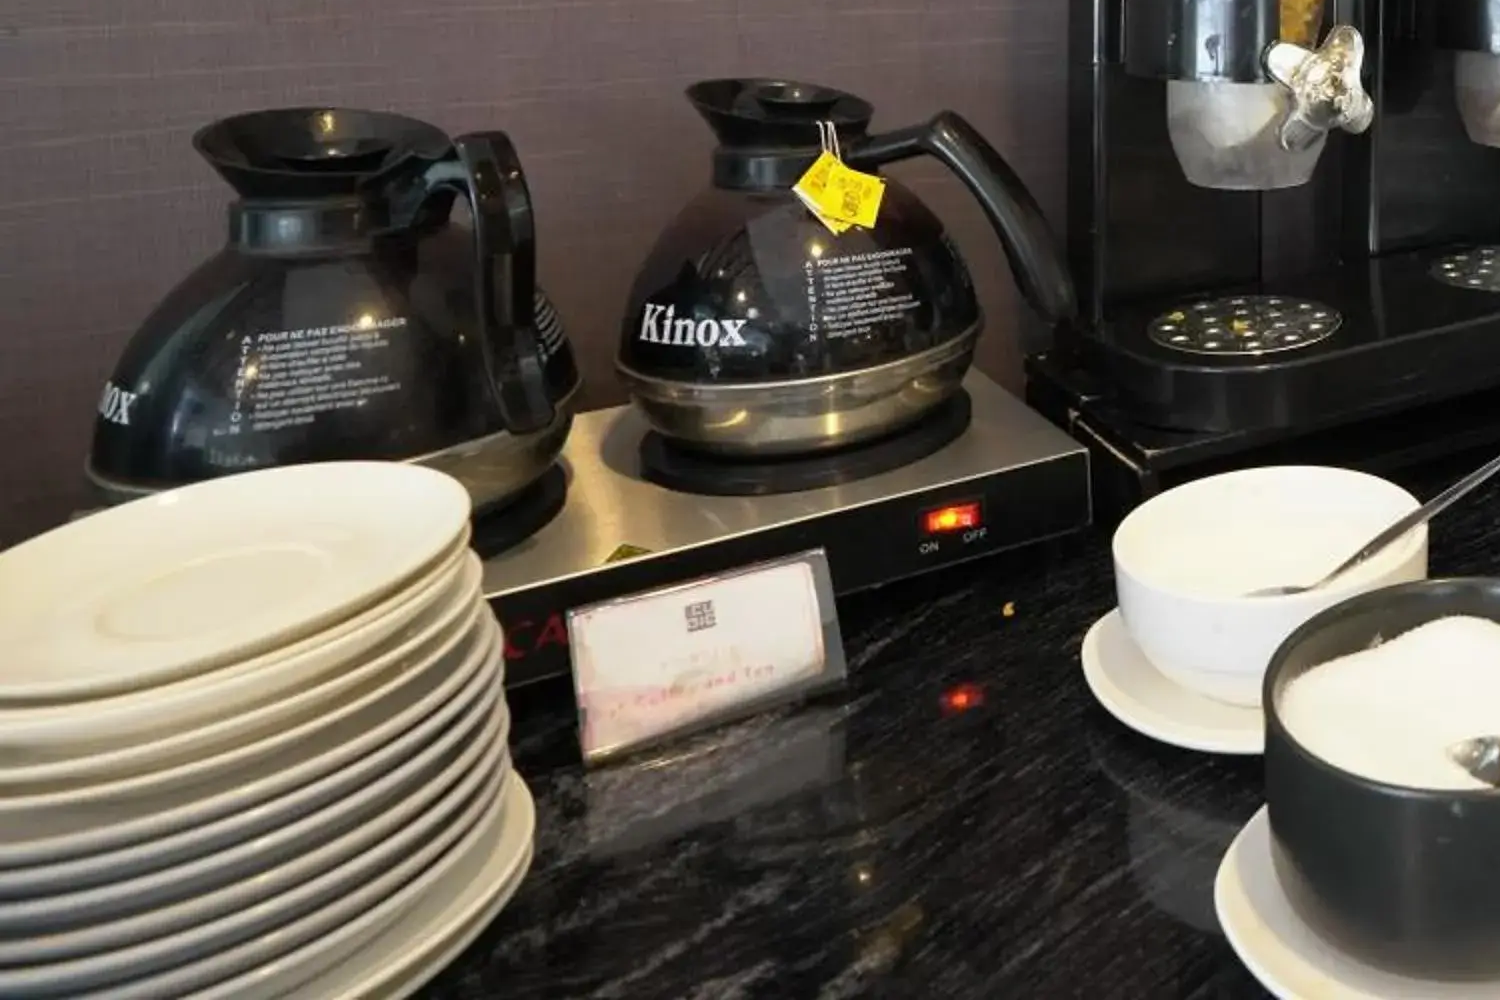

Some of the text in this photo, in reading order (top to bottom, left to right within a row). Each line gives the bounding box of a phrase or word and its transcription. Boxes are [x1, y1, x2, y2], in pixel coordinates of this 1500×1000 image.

[640, 303, 747, 347] Kinox
[919, 527, 987, 554] ON OFF
